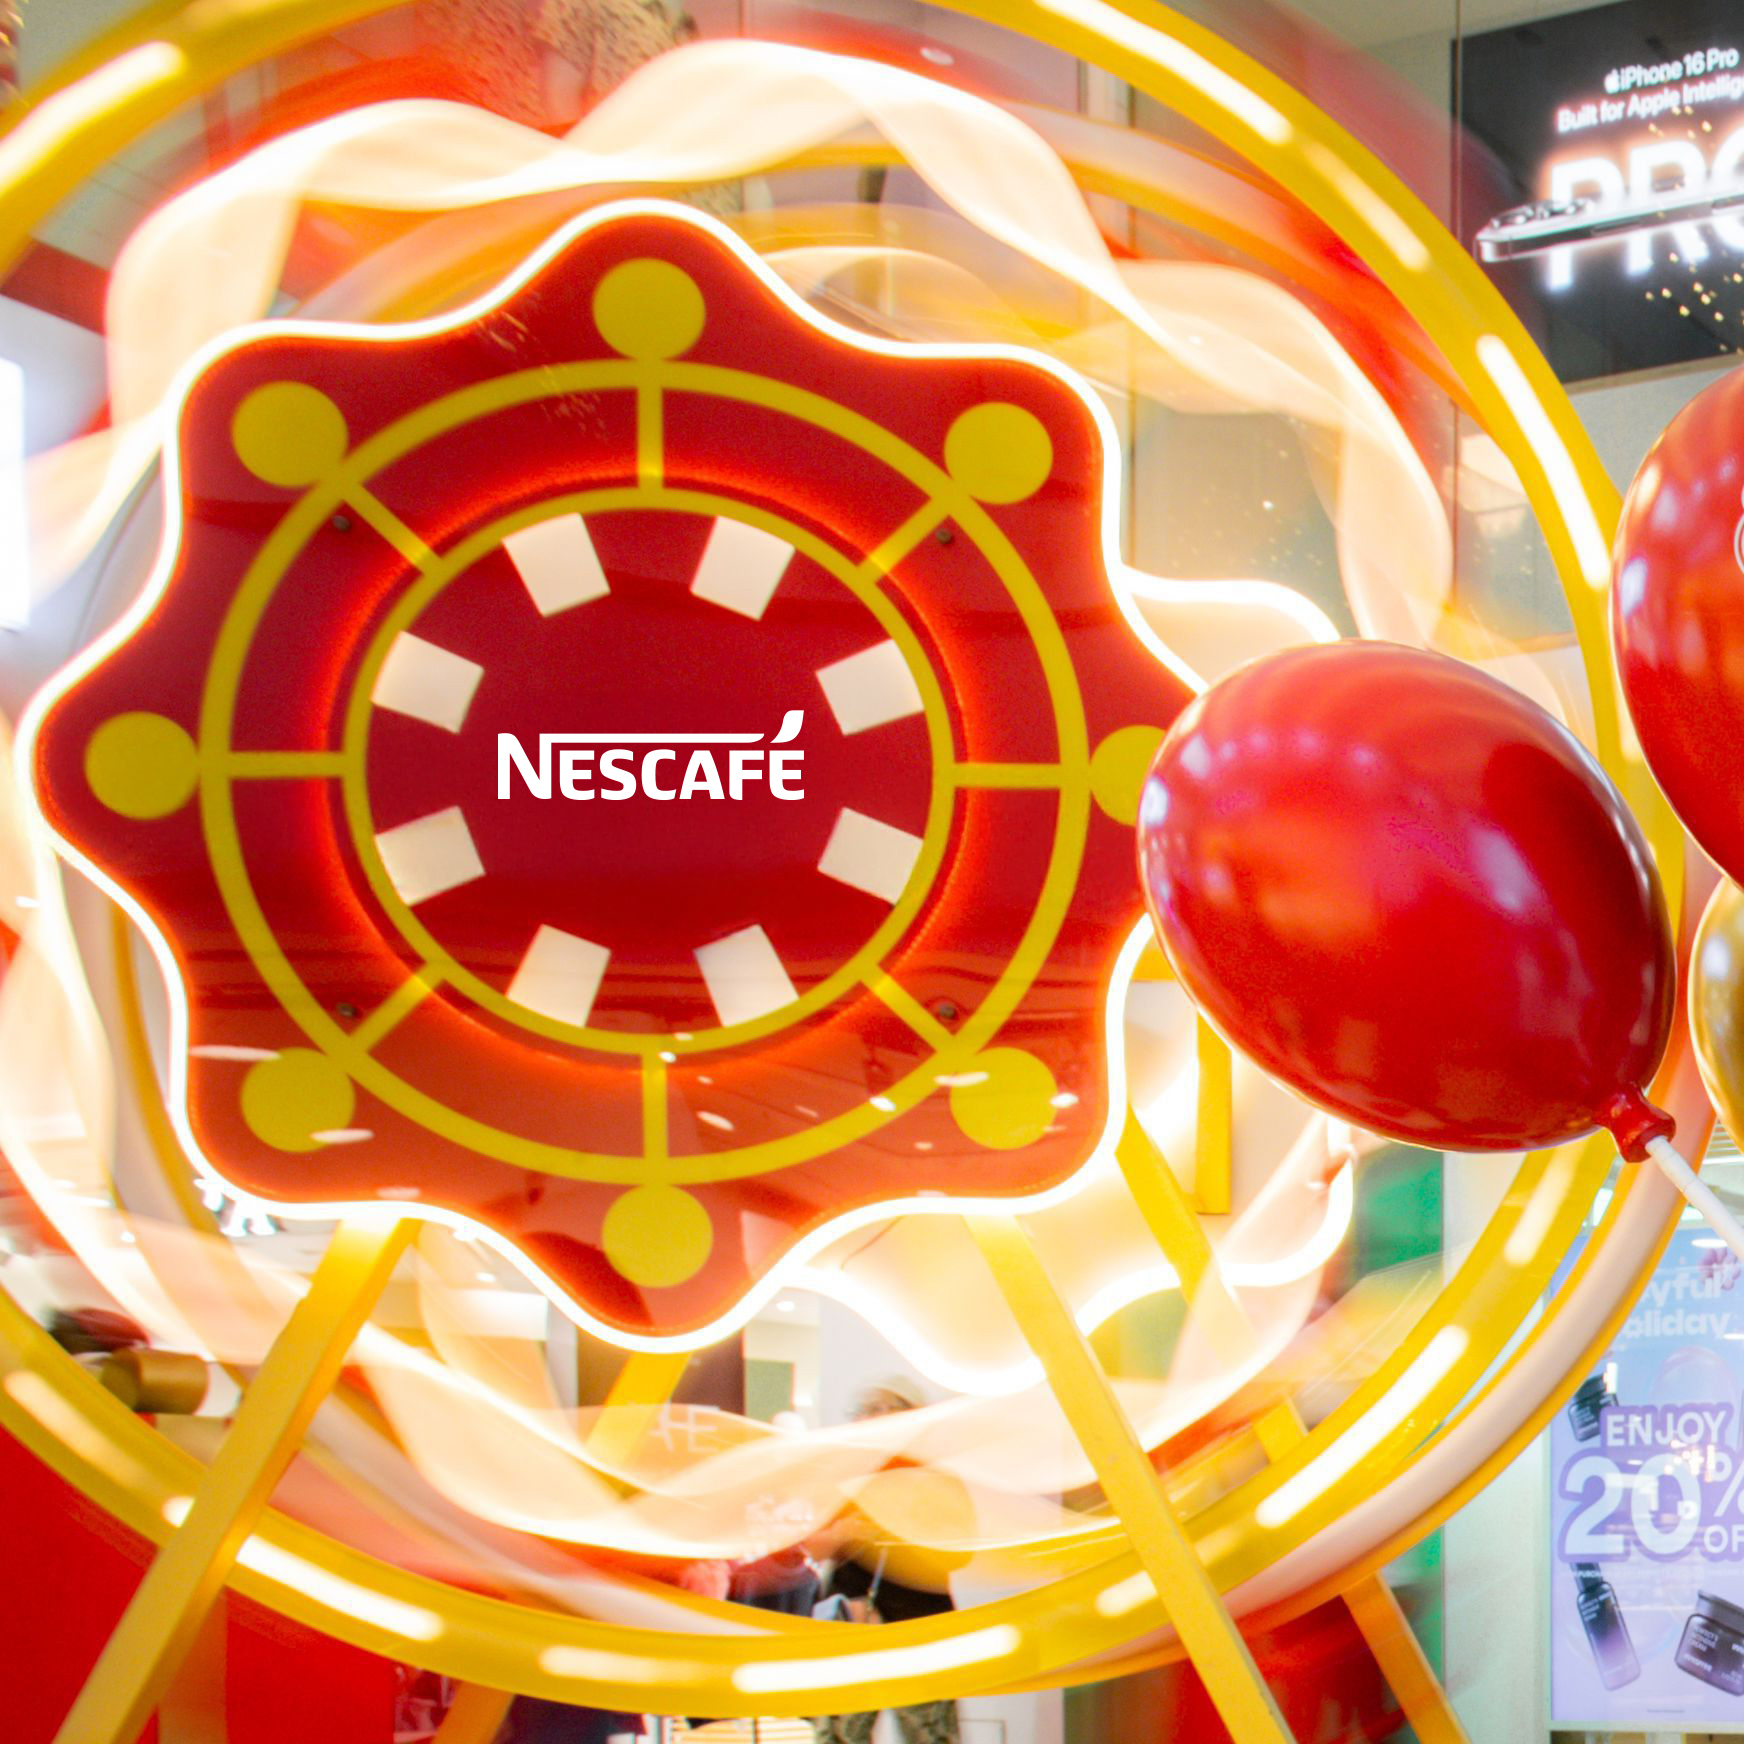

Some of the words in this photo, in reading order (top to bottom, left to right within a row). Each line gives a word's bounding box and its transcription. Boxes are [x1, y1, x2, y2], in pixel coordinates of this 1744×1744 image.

[1619, 61, 1684, 90] iPhone
[1683, 50, 1706, 77] 16
[1706, 47, 1740, 73] Pro
[1557, 103, 1599, 133] Built
[1600, 99, 1625, 122] for
[1627, 88, 1682, 119] Apple
[497, 709, 805, 801] NESCAFÉ
[1606, 1410, 1728, 1446] ENJOY
